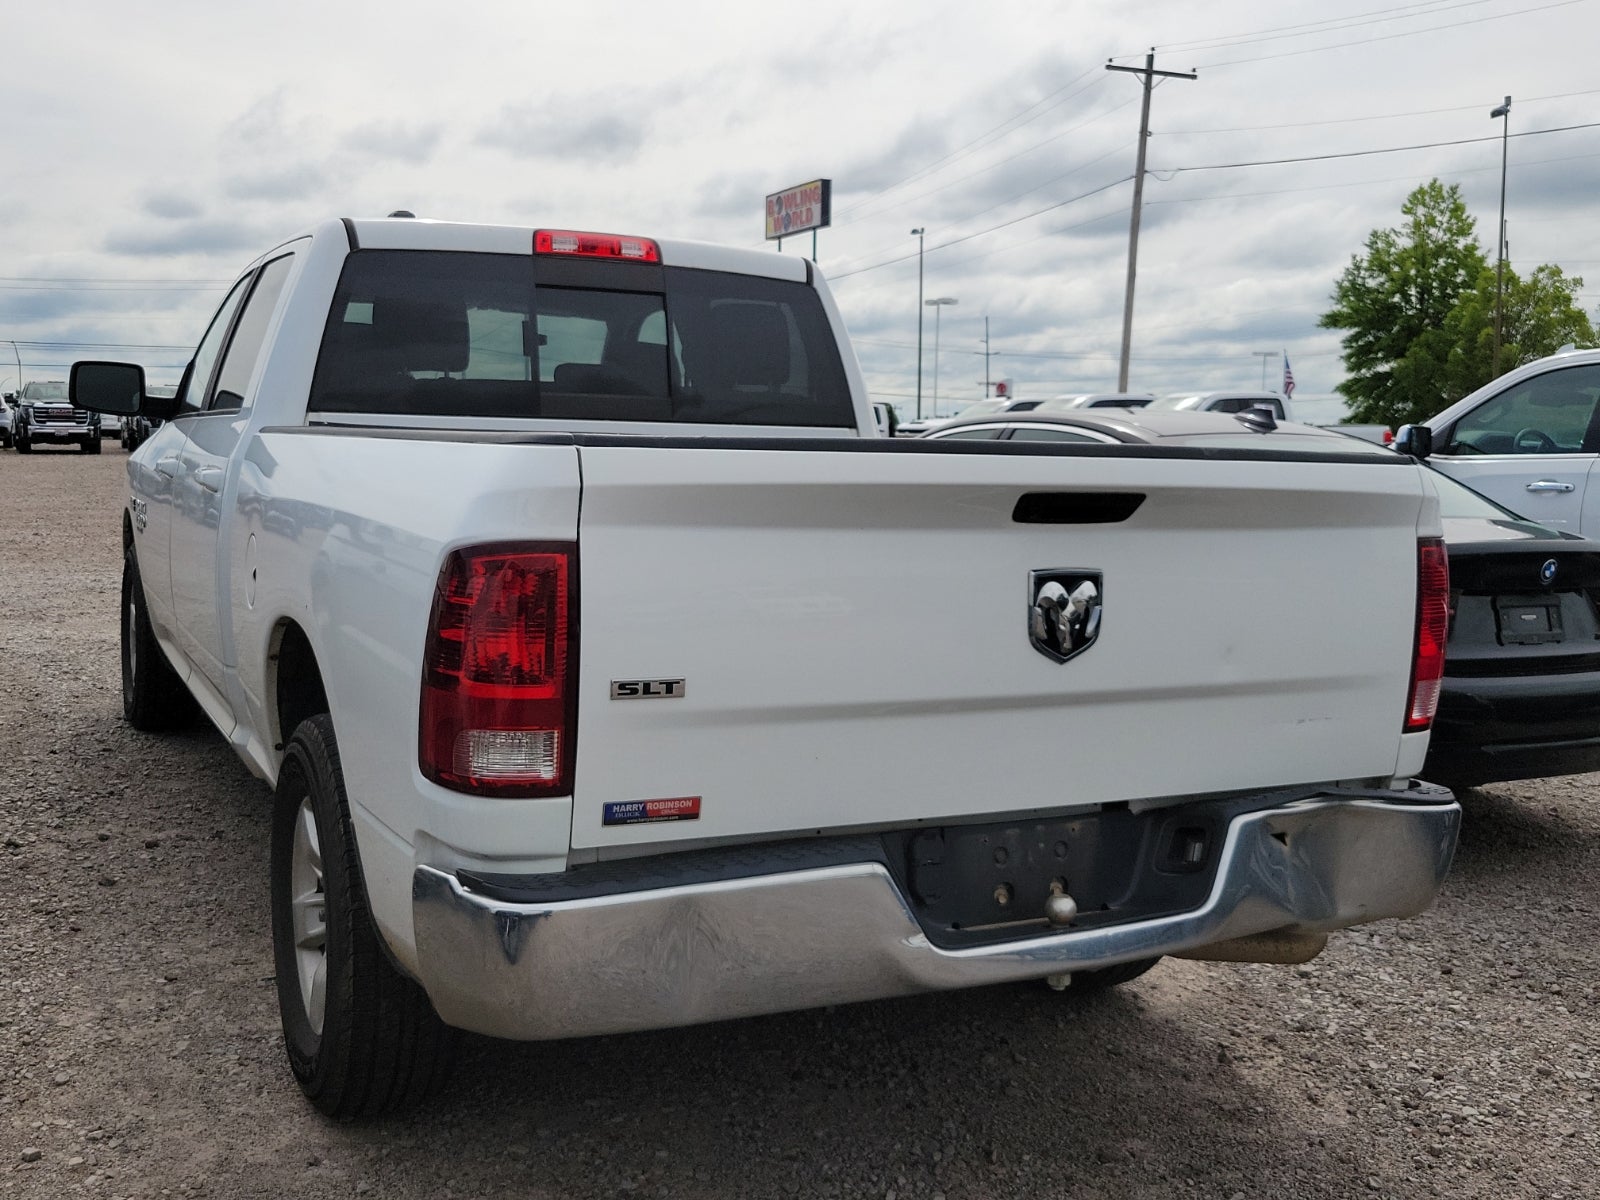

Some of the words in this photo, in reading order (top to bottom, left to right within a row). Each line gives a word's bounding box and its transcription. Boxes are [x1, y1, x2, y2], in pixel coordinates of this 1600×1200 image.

[774, 207, 813, 233] WORLD
[617, 681, 680, 696] SLT
[612, 803, 645, 813] HARRY
[646, 799, 693, 810] ROBINSON
